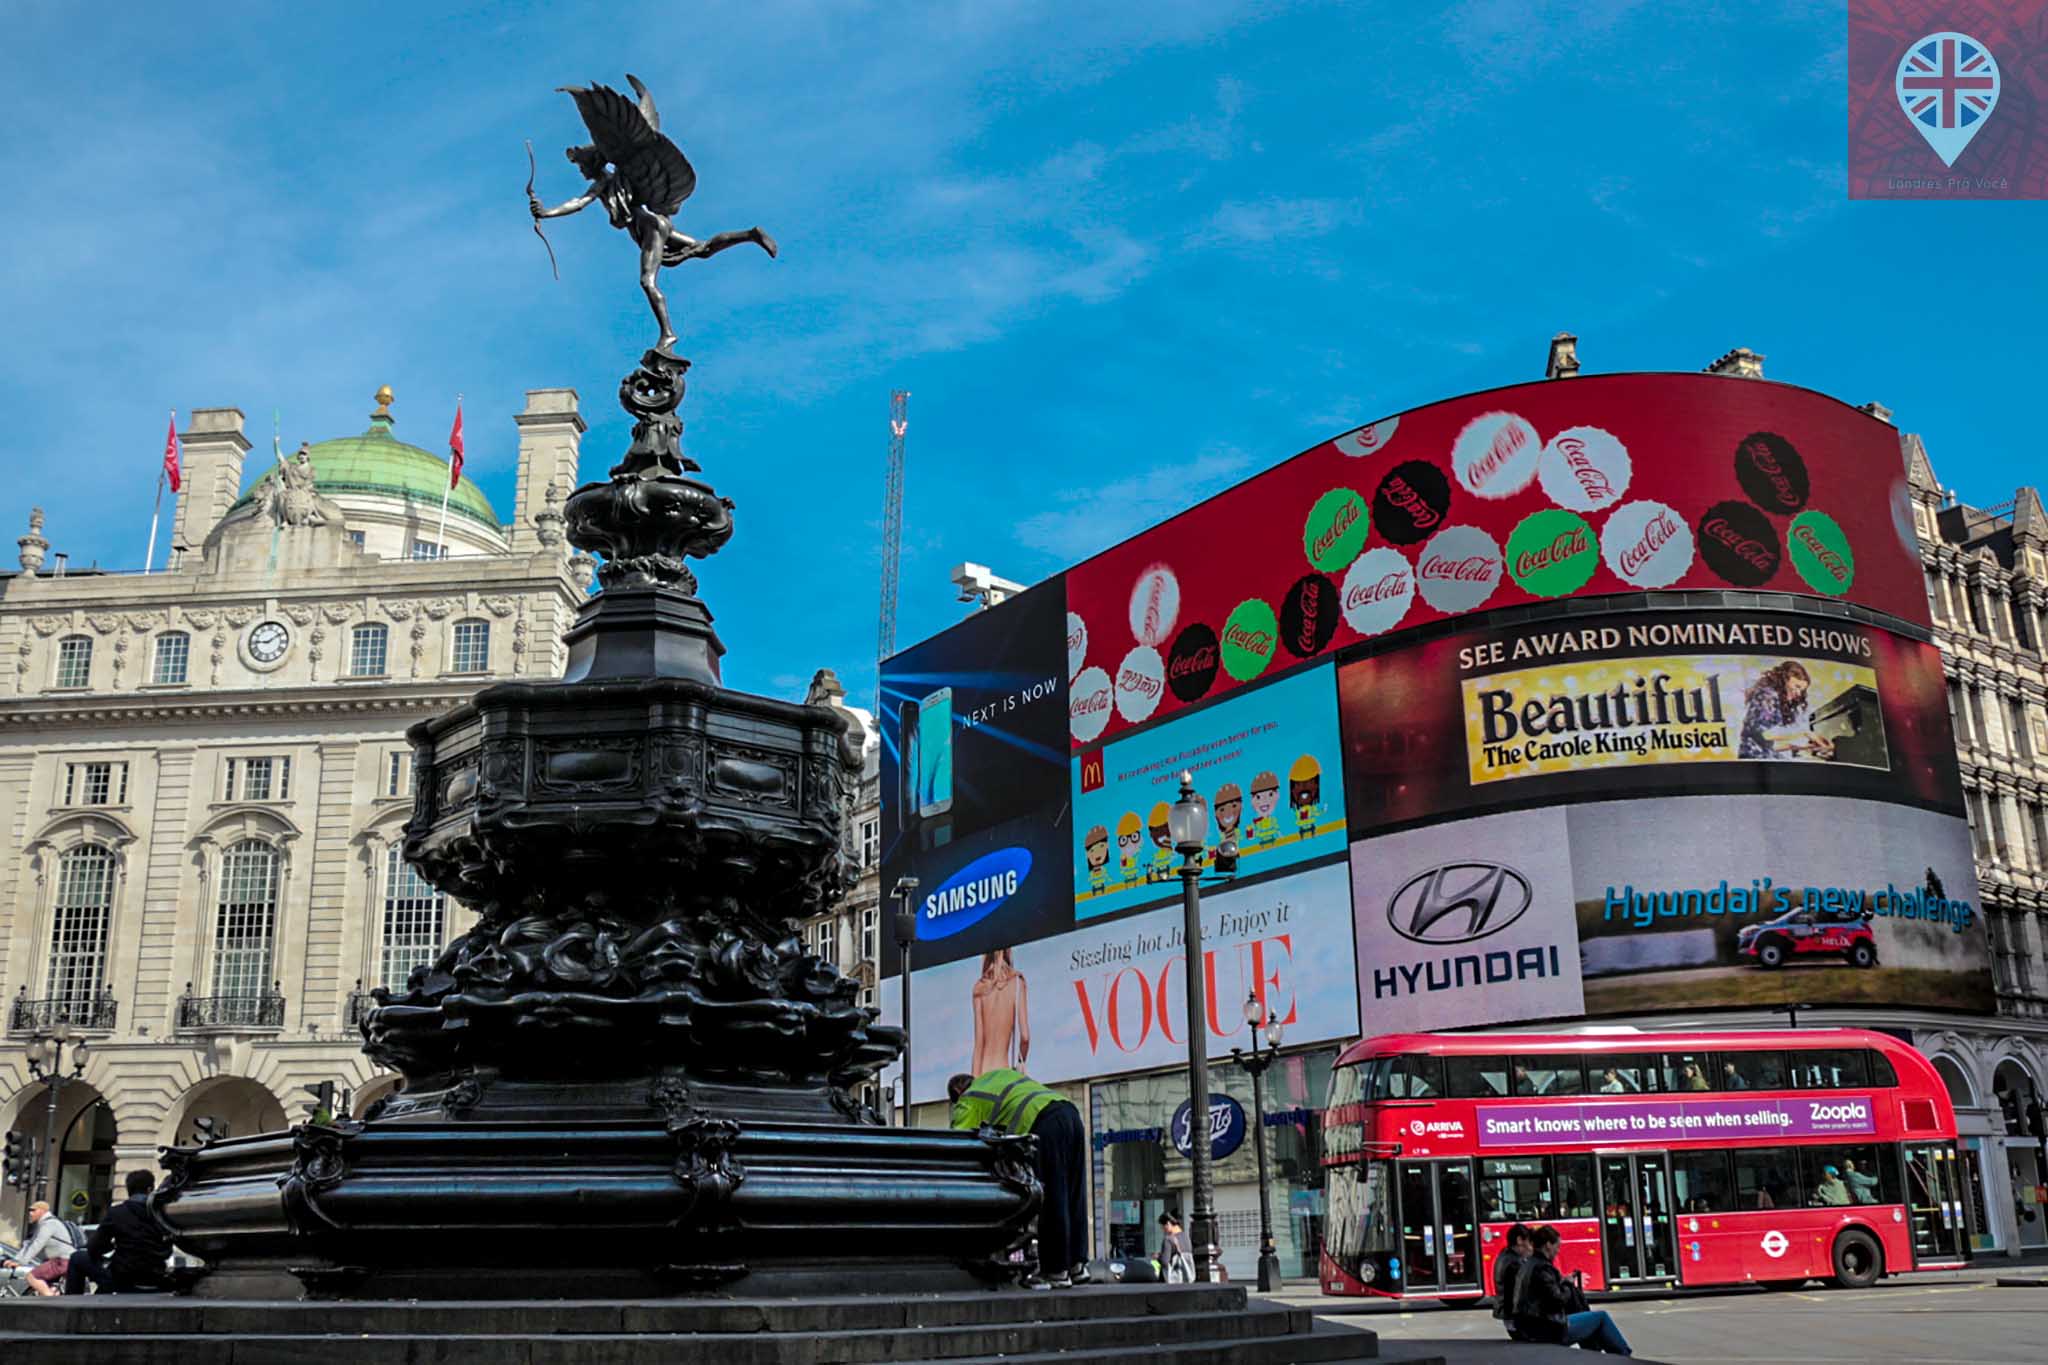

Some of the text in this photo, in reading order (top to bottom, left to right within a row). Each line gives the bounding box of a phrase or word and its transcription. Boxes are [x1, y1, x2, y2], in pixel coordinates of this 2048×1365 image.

[1459, 623, 1873, 669] SEE AWARD NOMINATED SHOWS
[961, 676, 1058, 730] NEXT IS NOW
[1478, 672, 1727, 745] Beautiful
[1482, 727, 1729, 768] The Carole King Musical
[926, 869, 1018, 919] SAMSUNG
[1604, 877, 1972, 934] Hyundai's new challenge
[1069, 901, 1290, 971] Sizzling hot Jue. Enjoy it
[1374, 945, 1560, 999] HYUNDAI
[1426, 1121, 1464, 1132] ARRIVA
[1486, 1109, 1793, 1134] Smart knows where to be seen when selling.
[1809, 1102, 1866, 1122] Zoopla
